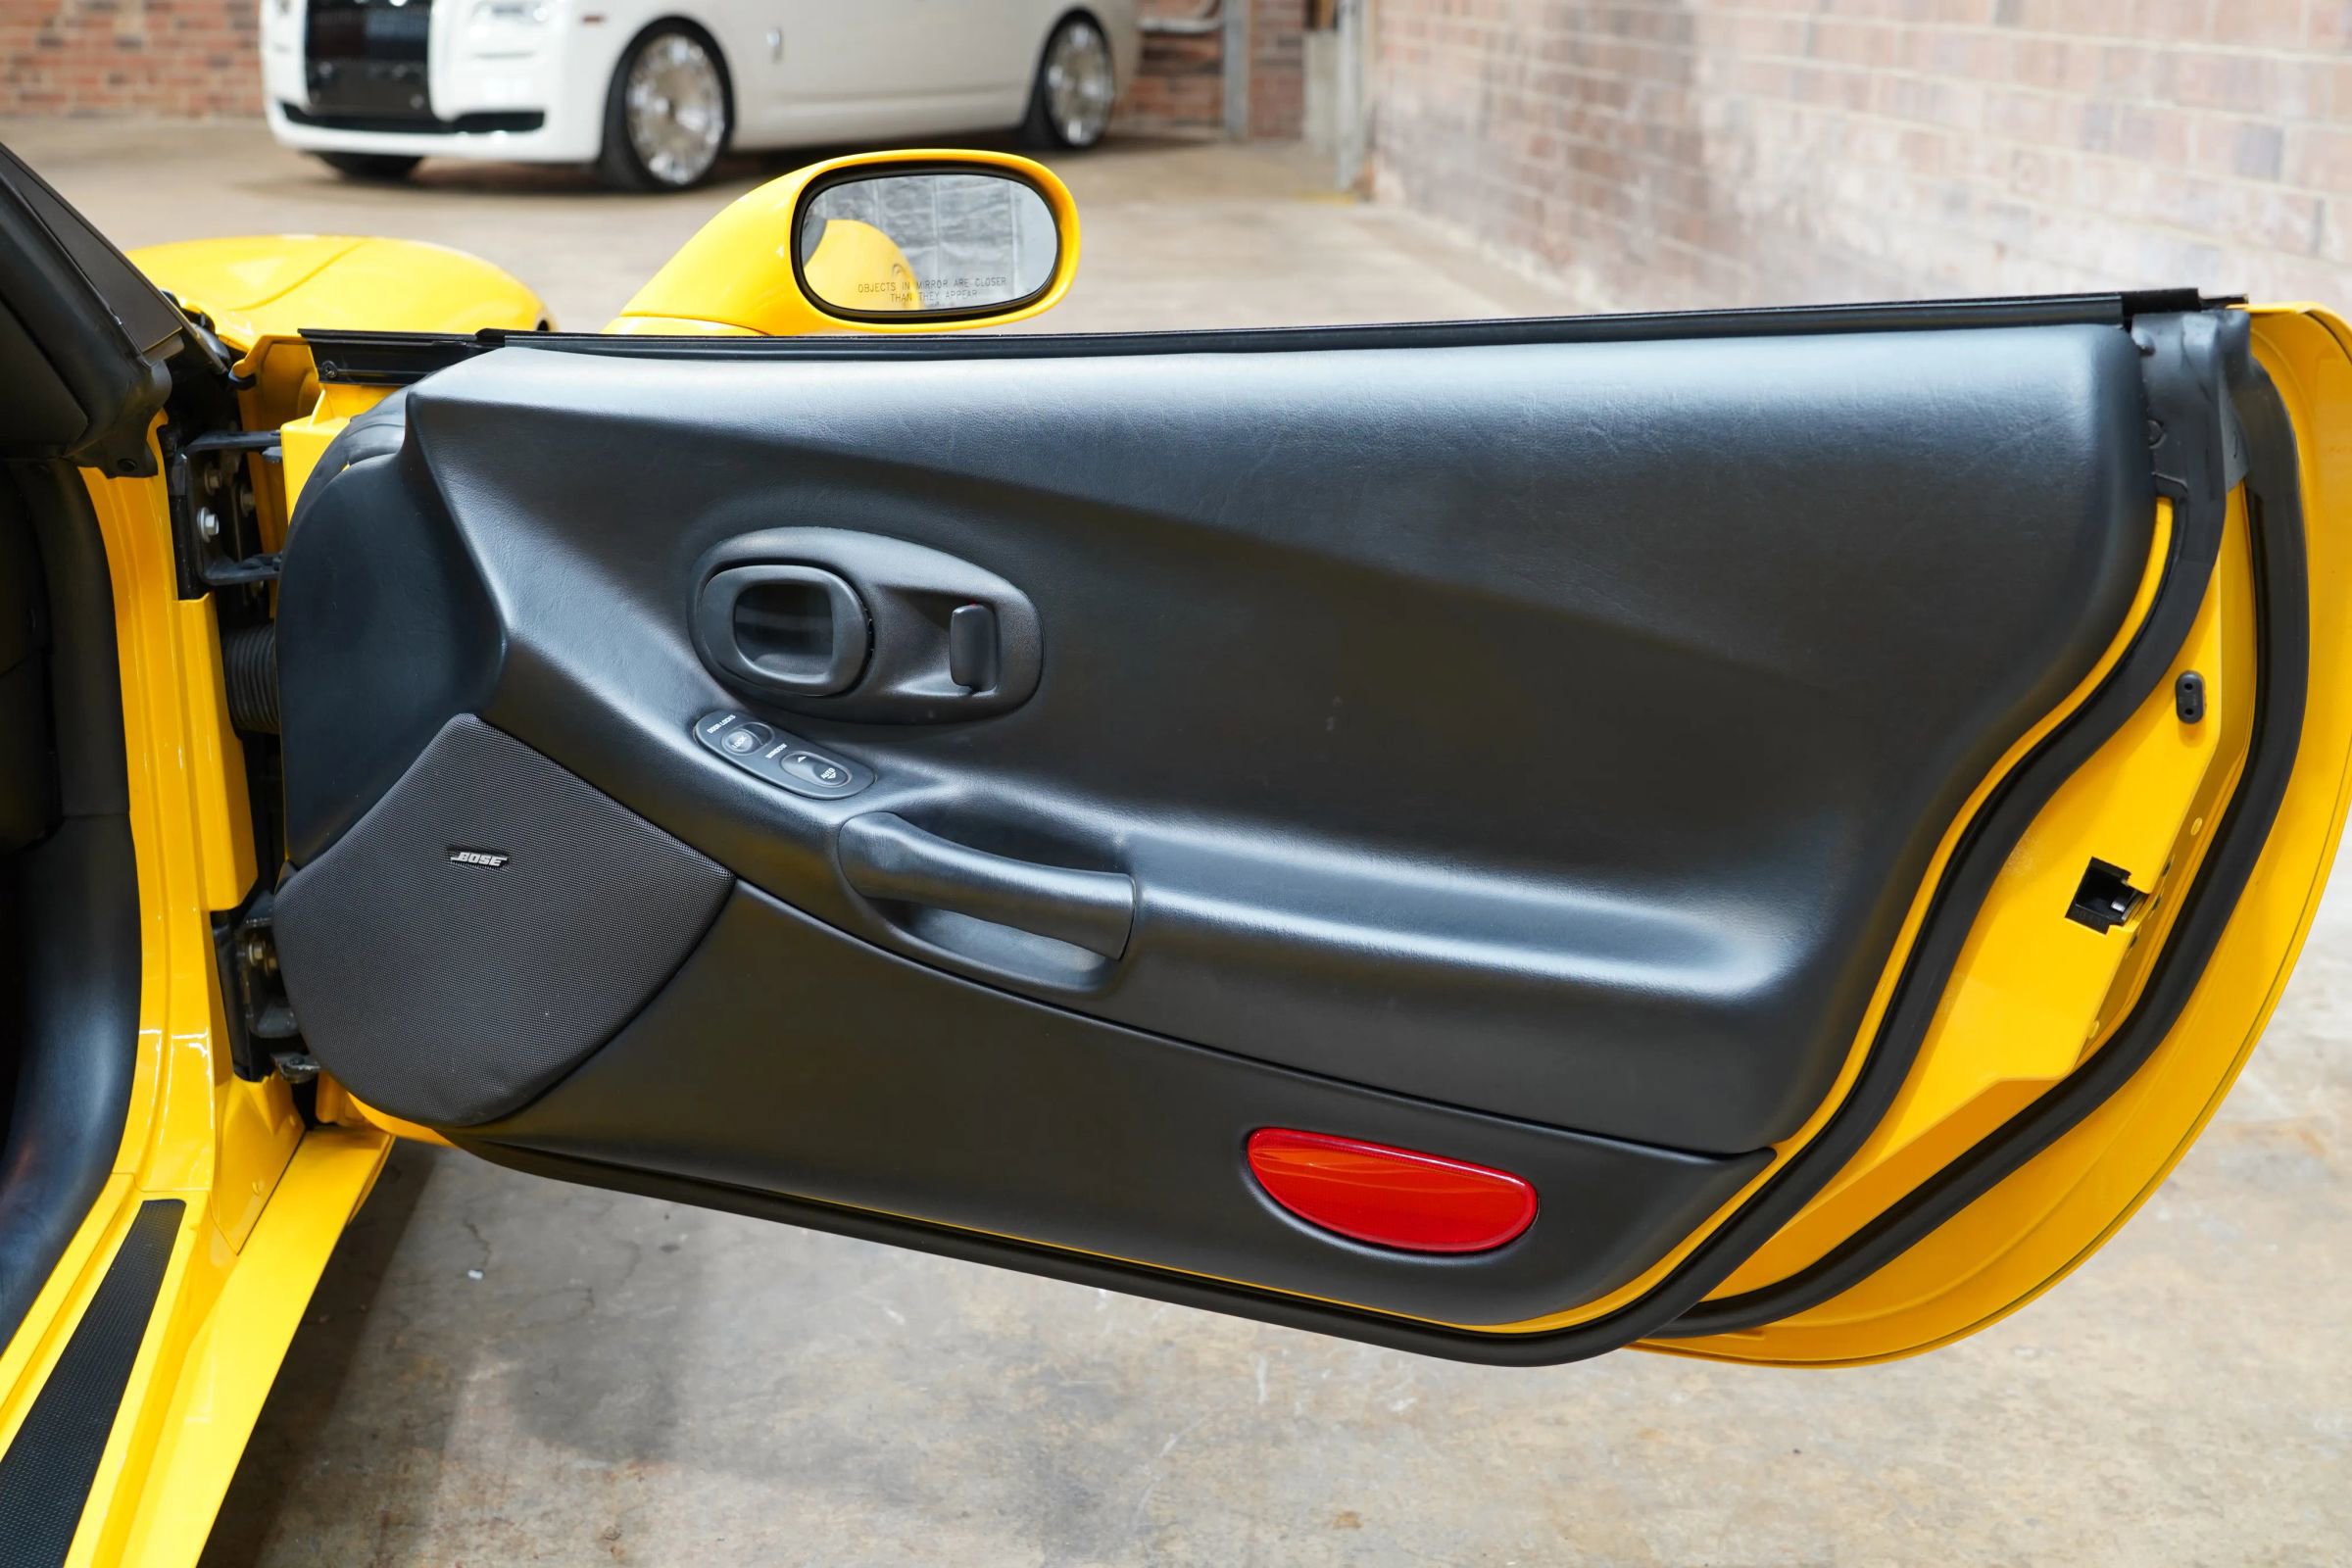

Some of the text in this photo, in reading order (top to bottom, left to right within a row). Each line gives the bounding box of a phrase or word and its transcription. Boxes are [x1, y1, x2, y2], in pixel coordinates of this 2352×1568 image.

[858, 276, 1006, 293] OBJECTS IN MIRROR ARE CLOSER
[890, 289, 977, 302] THAN THEY APPEAR
[820, 767, 835, 779] AUTO
[450, 852, 508, 866] BOSE
